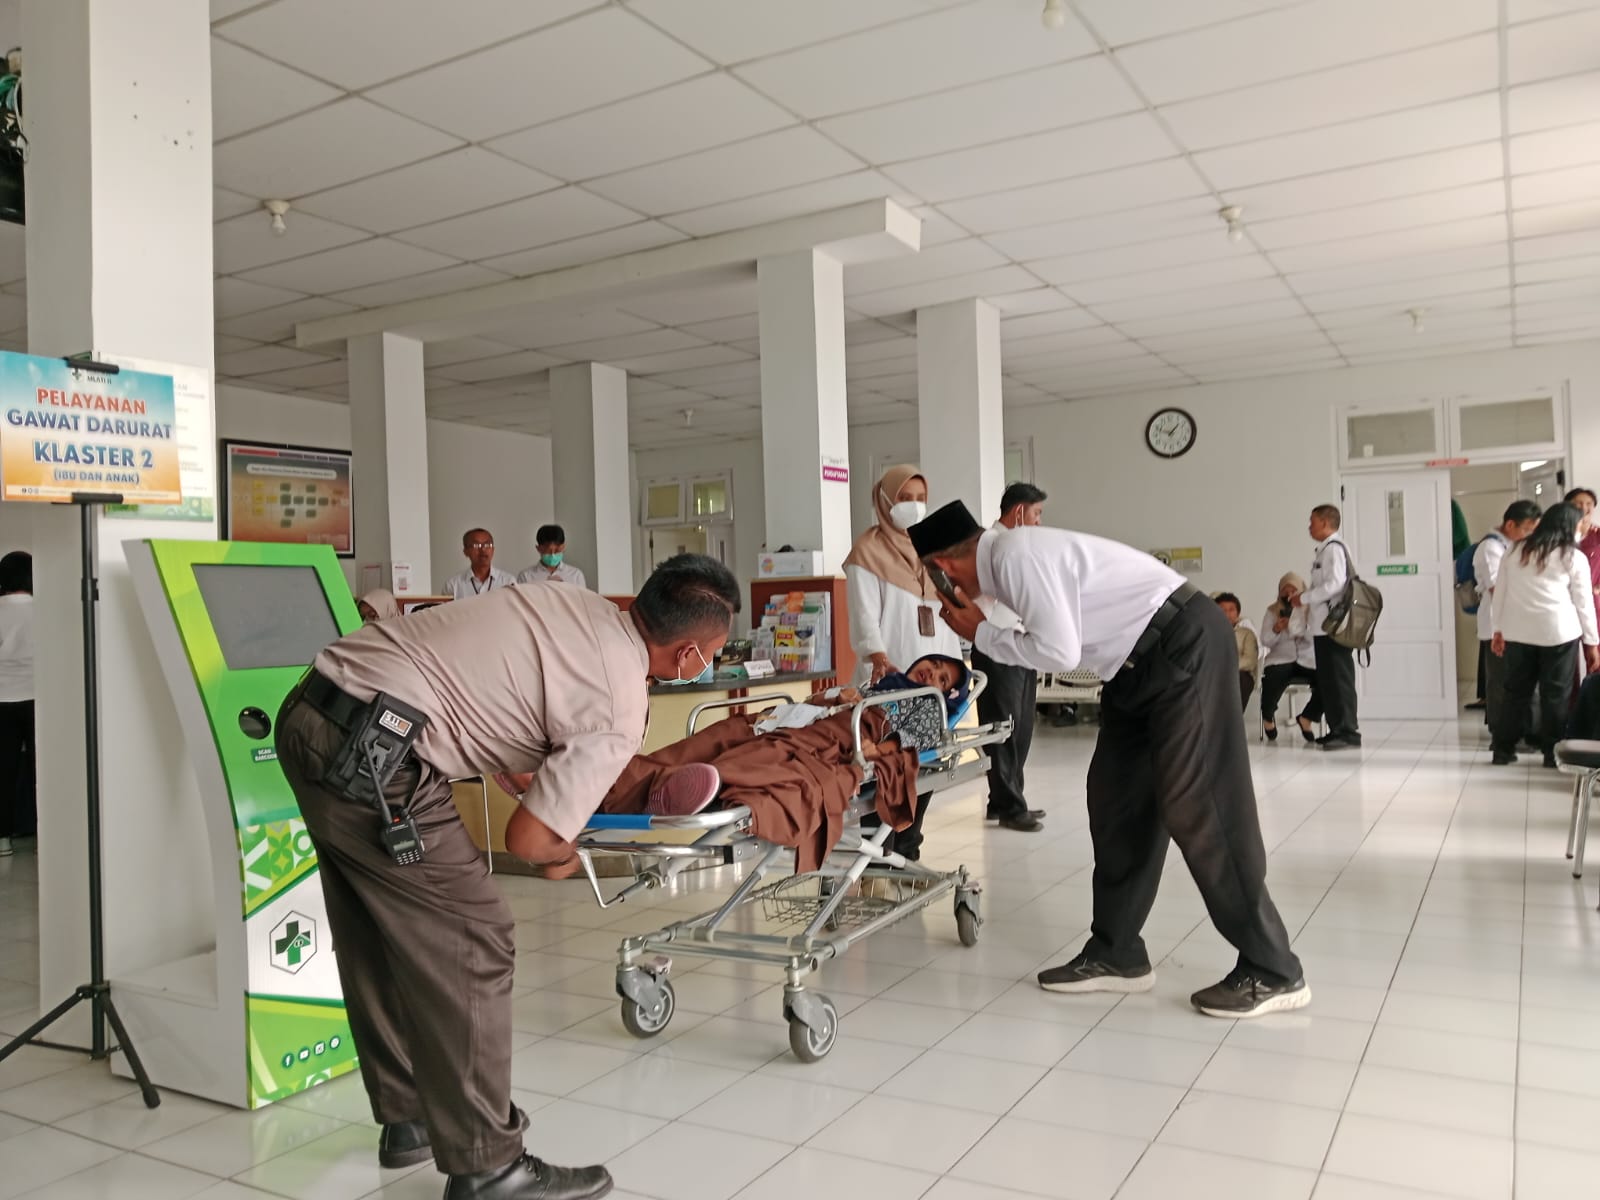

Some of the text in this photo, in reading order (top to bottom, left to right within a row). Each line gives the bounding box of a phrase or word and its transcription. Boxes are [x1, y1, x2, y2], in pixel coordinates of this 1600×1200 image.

[36, 388, 146, 415] PELAYANAN
[7, 409, 172, 439] GAWAT DARURAT
[34, 441, 154, 469] KLASTER 2
[54, 470, 140, 485] (IBU DAN ANAK)
